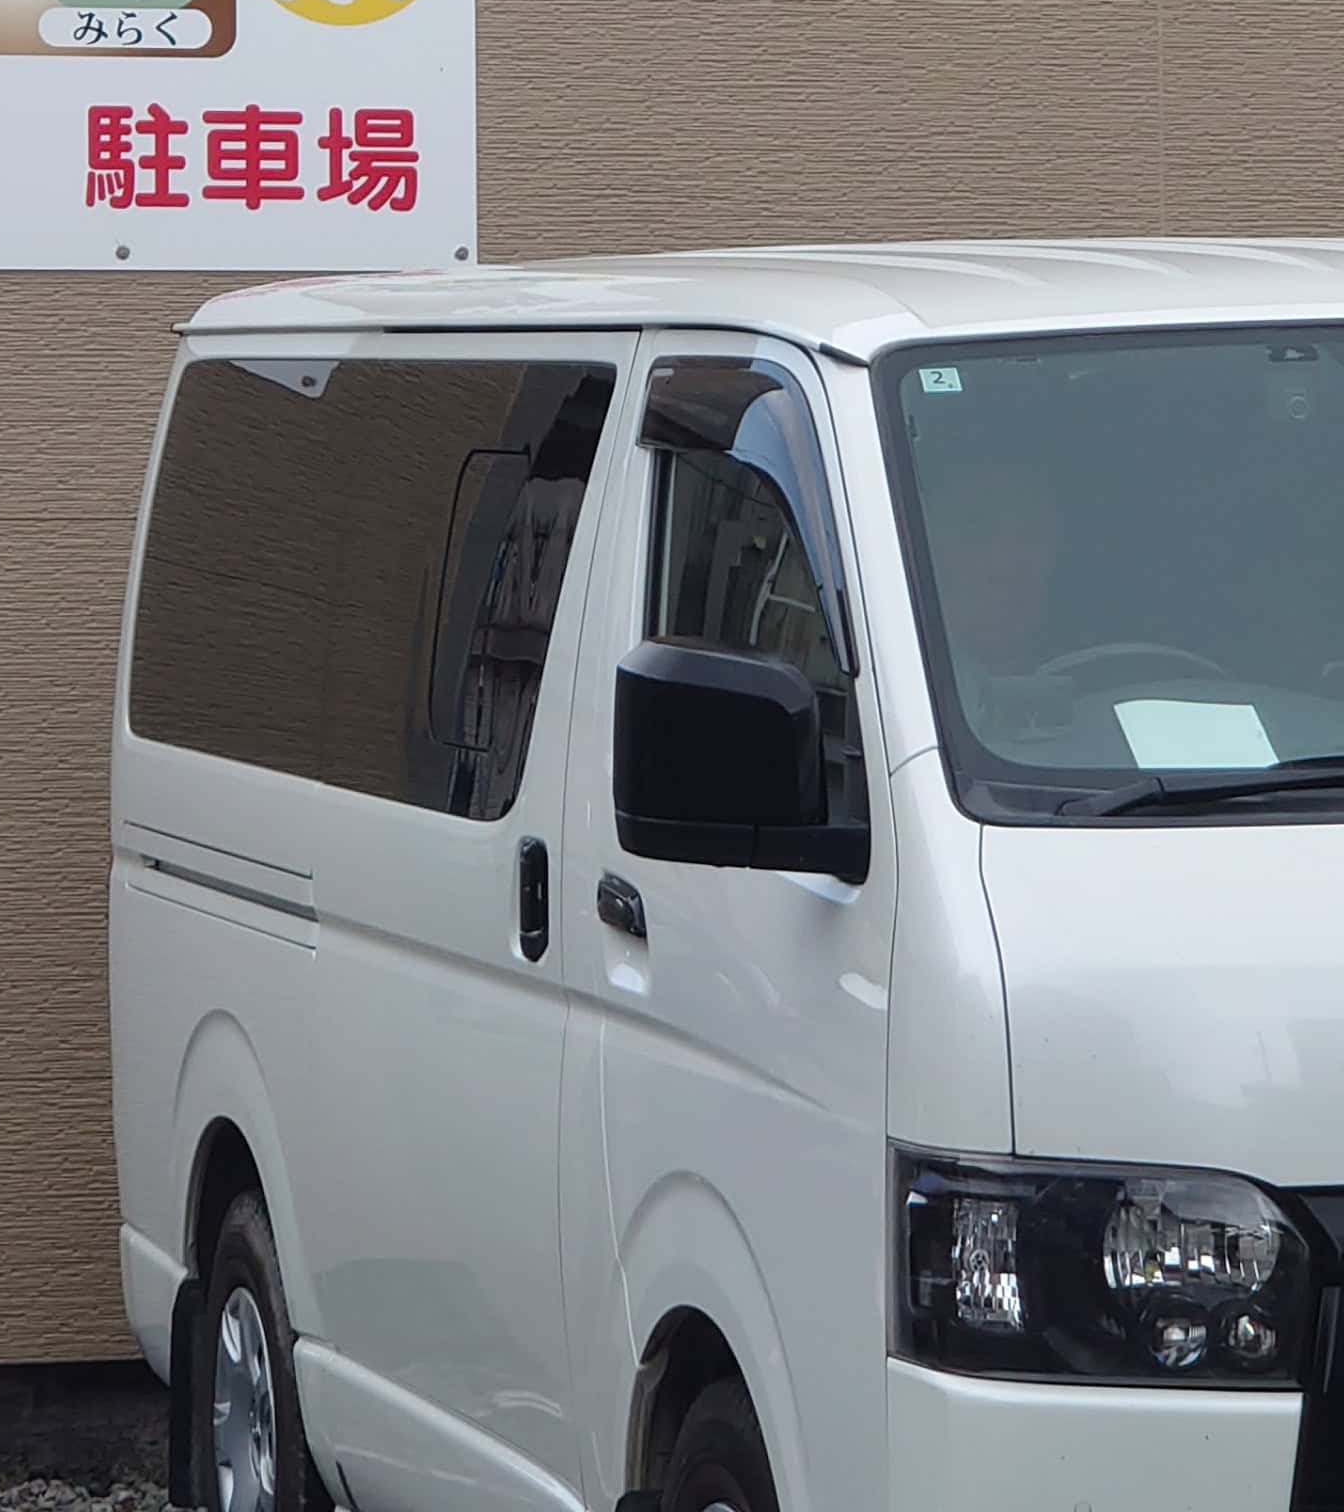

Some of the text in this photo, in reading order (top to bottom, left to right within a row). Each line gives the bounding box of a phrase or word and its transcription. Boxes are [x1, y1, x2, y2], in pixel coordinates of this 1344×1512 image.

[72, 10, 181, 46] みらく
[85, 102, 420, 212] 駐車場
